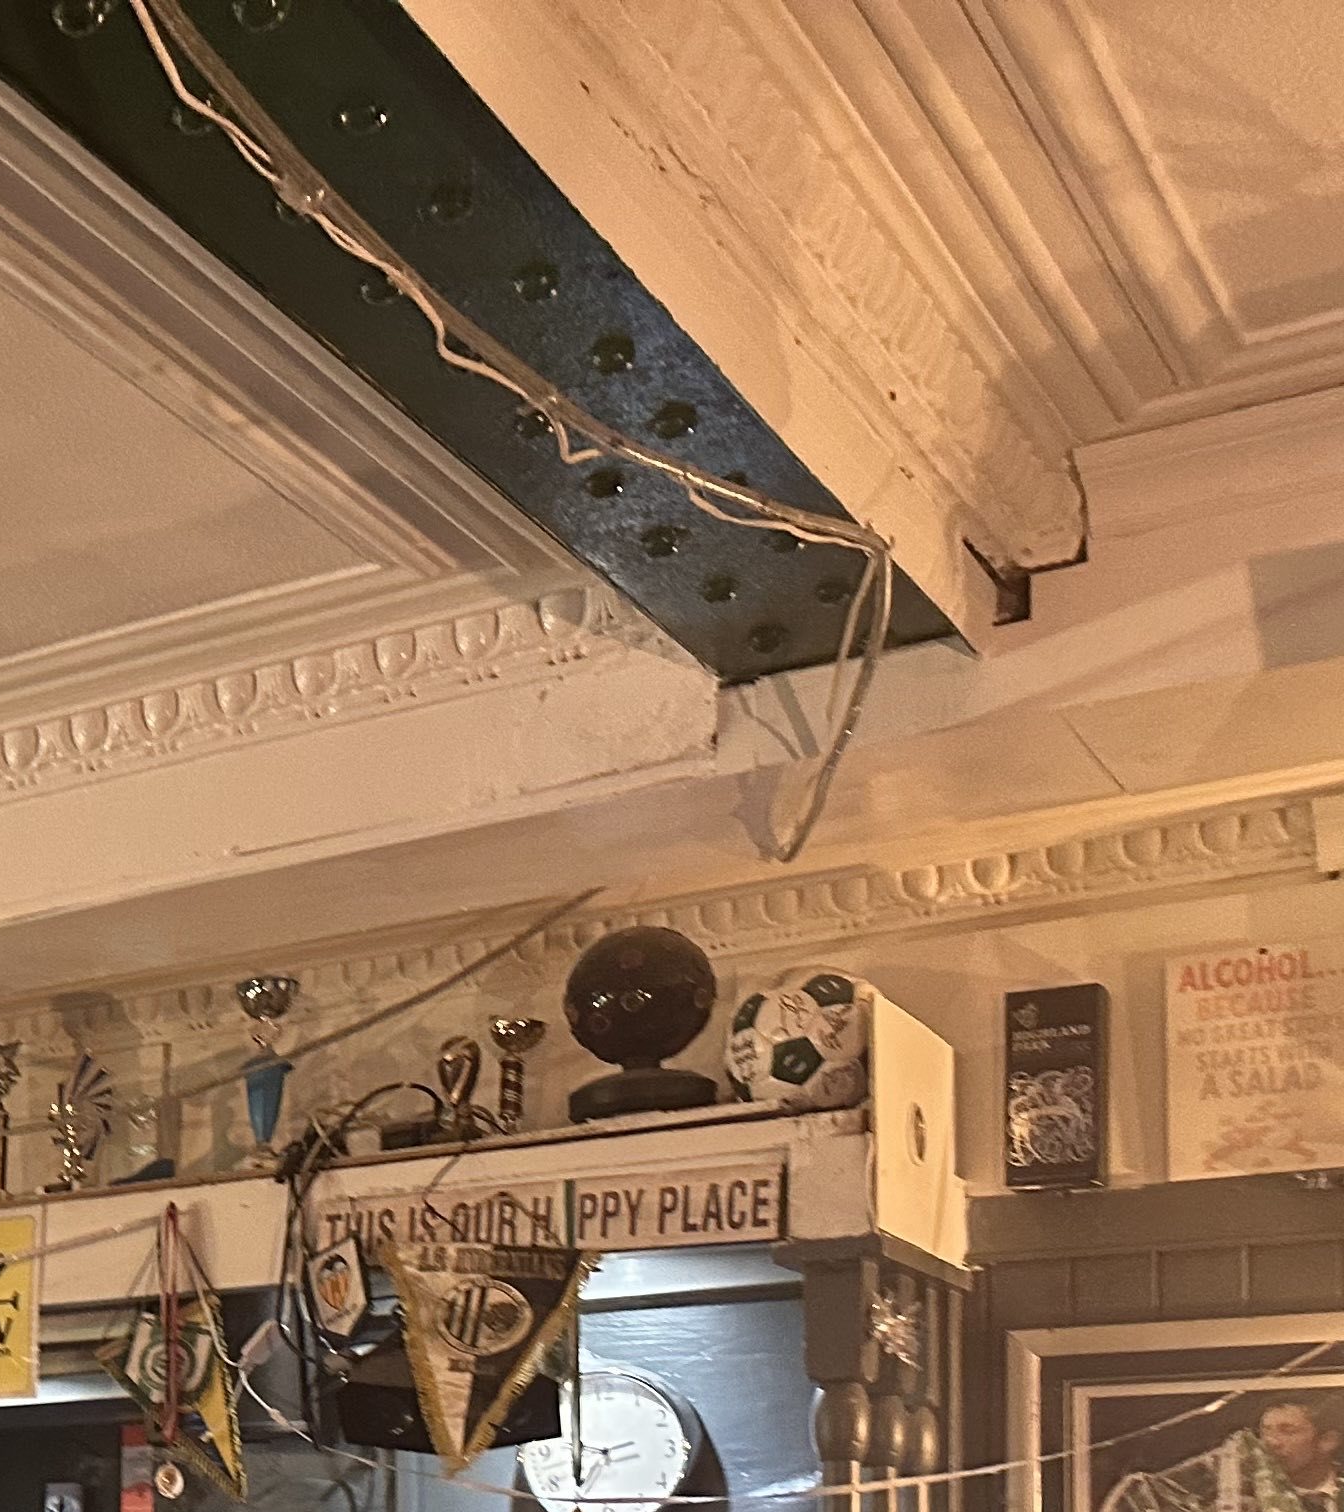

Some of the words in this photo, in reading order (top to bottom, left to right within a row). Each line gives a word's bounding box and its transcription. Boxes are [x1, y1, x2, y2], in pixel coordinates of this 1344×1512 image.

[325, 1205, 397, 1250] THIS
[408, 1204, 438, 1244] IS
[450, 1199, 516, 1246] OUR
[531, 1187, 647, 1248] HPPY
[658, 1178, 772, 1235] PLACE
